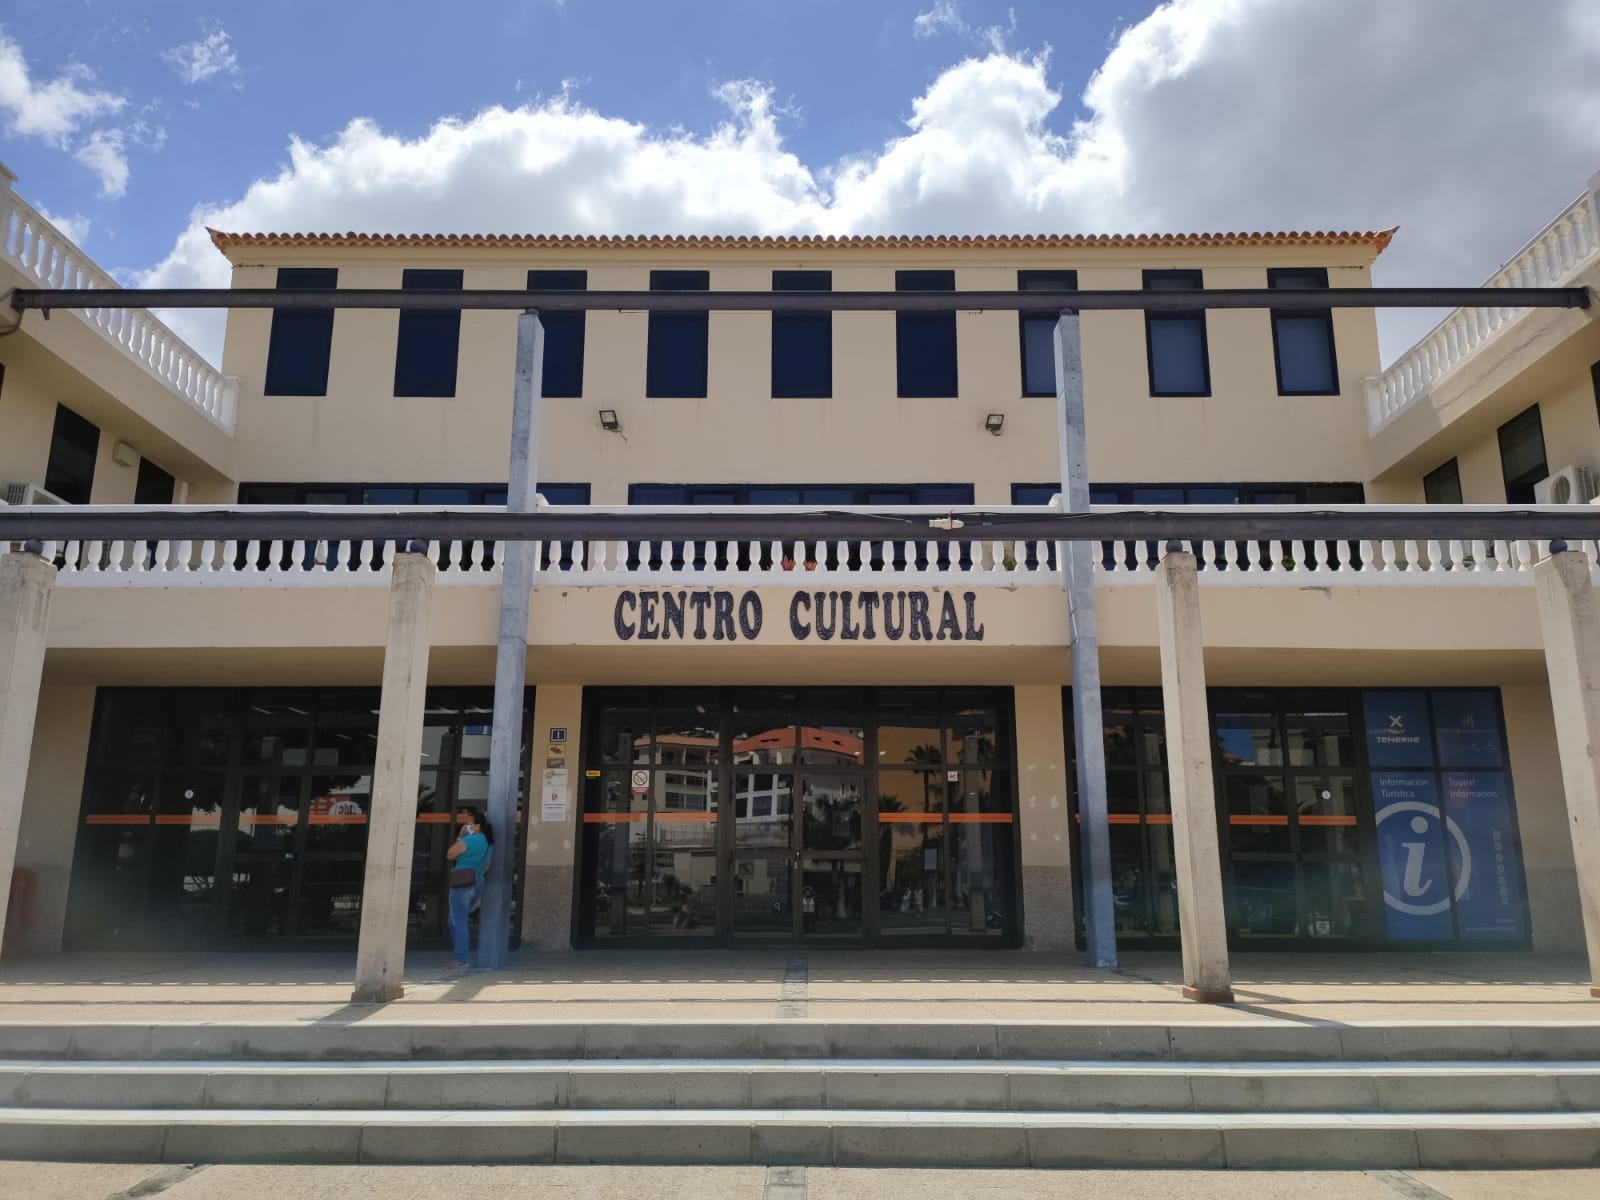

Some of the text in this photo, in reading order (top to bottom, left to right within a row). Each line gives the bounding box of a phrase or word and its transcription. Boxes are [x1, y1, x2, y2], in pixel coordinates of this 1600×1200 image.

[614, 590, 985, 642] CENTRO CULTURAL
[1376, 736, 1420, 744] TENERIFE
[1448, 778, 1476, 786] Tourist
[1450, 790, 1497, 798] Information
